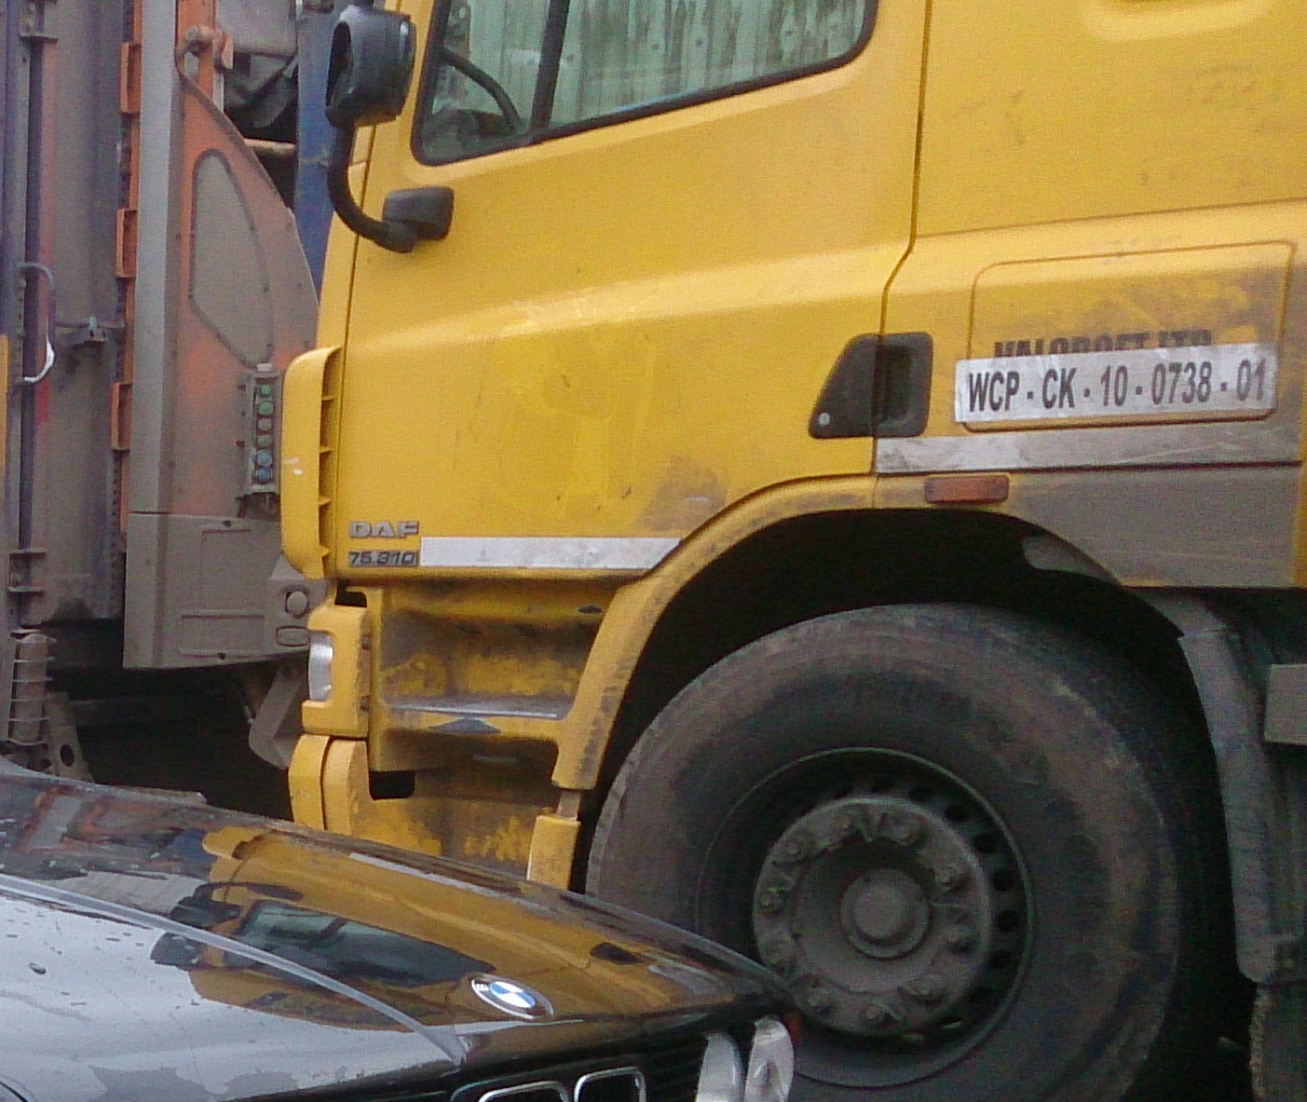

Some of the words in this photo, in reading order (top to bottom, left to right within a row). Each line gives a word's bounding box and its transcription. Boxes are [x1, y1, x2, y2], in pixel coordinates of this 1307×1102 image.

[968, 368, 1019, 412] WCP
[1042, 367, 1077, 409] CK
[1100, 365, 1129, 407] 10
[1151, 362, 1212, 405] 0738
[1237, 359, 1266, 401] 01
[349, 521, 419, 538] DAF
